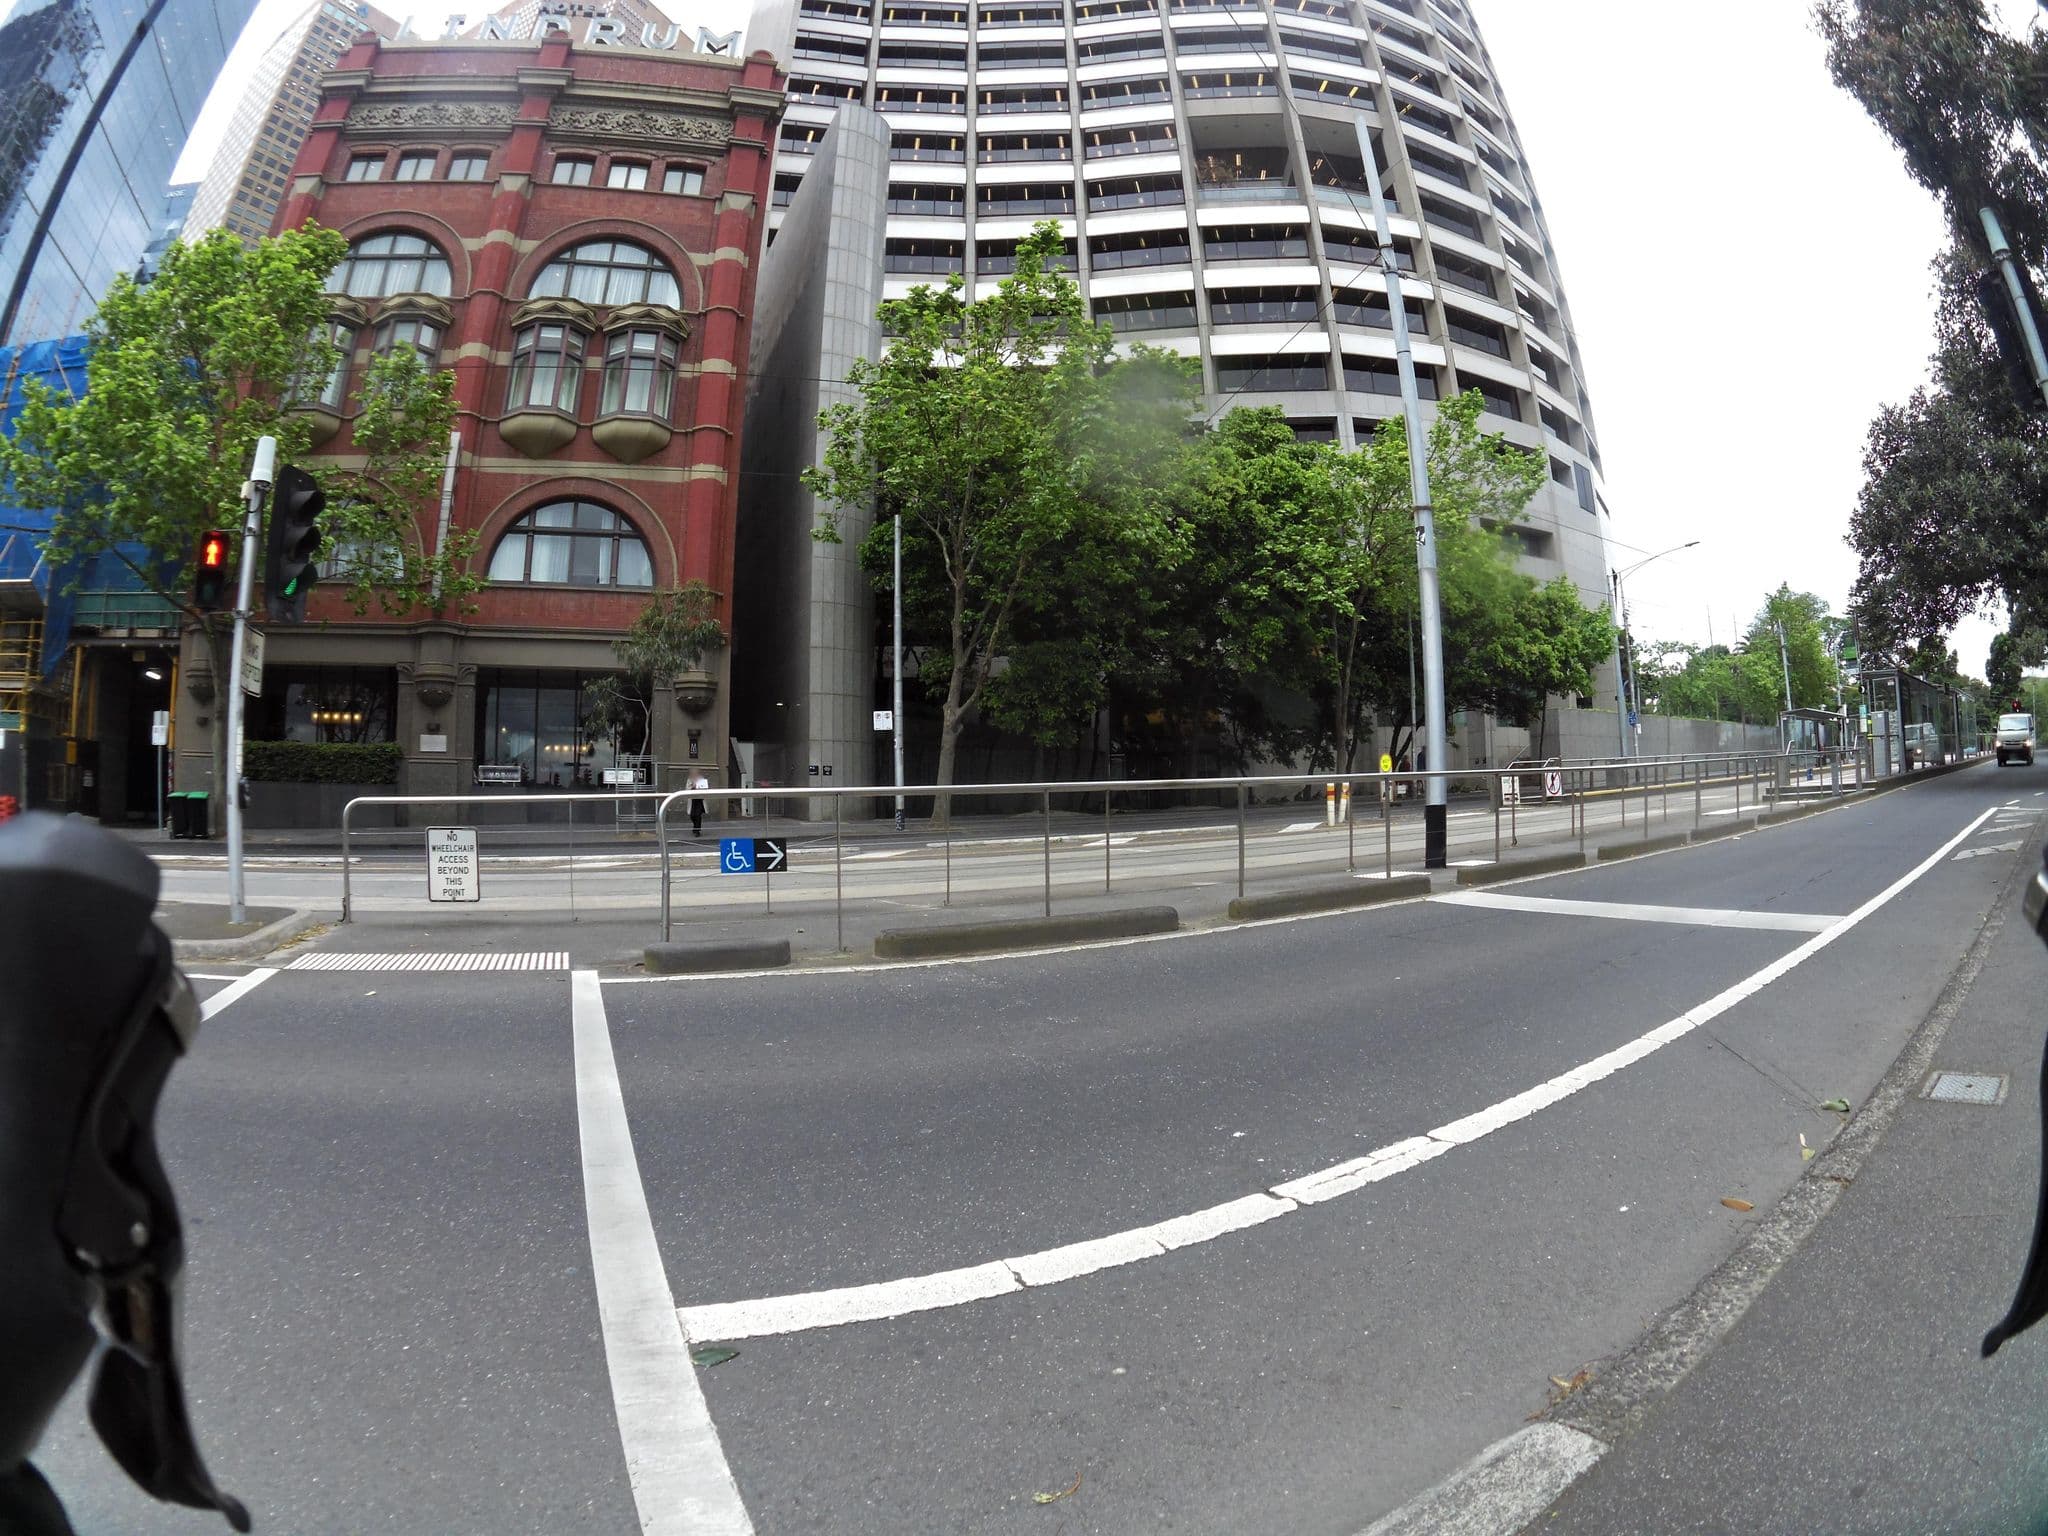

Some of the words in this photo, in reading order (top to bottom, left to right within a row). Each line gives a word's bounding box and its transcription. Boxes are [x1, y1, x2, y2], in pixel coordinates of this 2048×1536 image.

[394, 14, 743, 61] LINDRUM
[447, 833, 458, 841] NO
[432, 844, 475, 852] WHEELCHAIR
[438, 855, 469, 863] ACCESS
[437, 866, 469, 874] BEYOND
[445, 877, 463, 885] THIS
[442, 888, 465, 896] POINT
